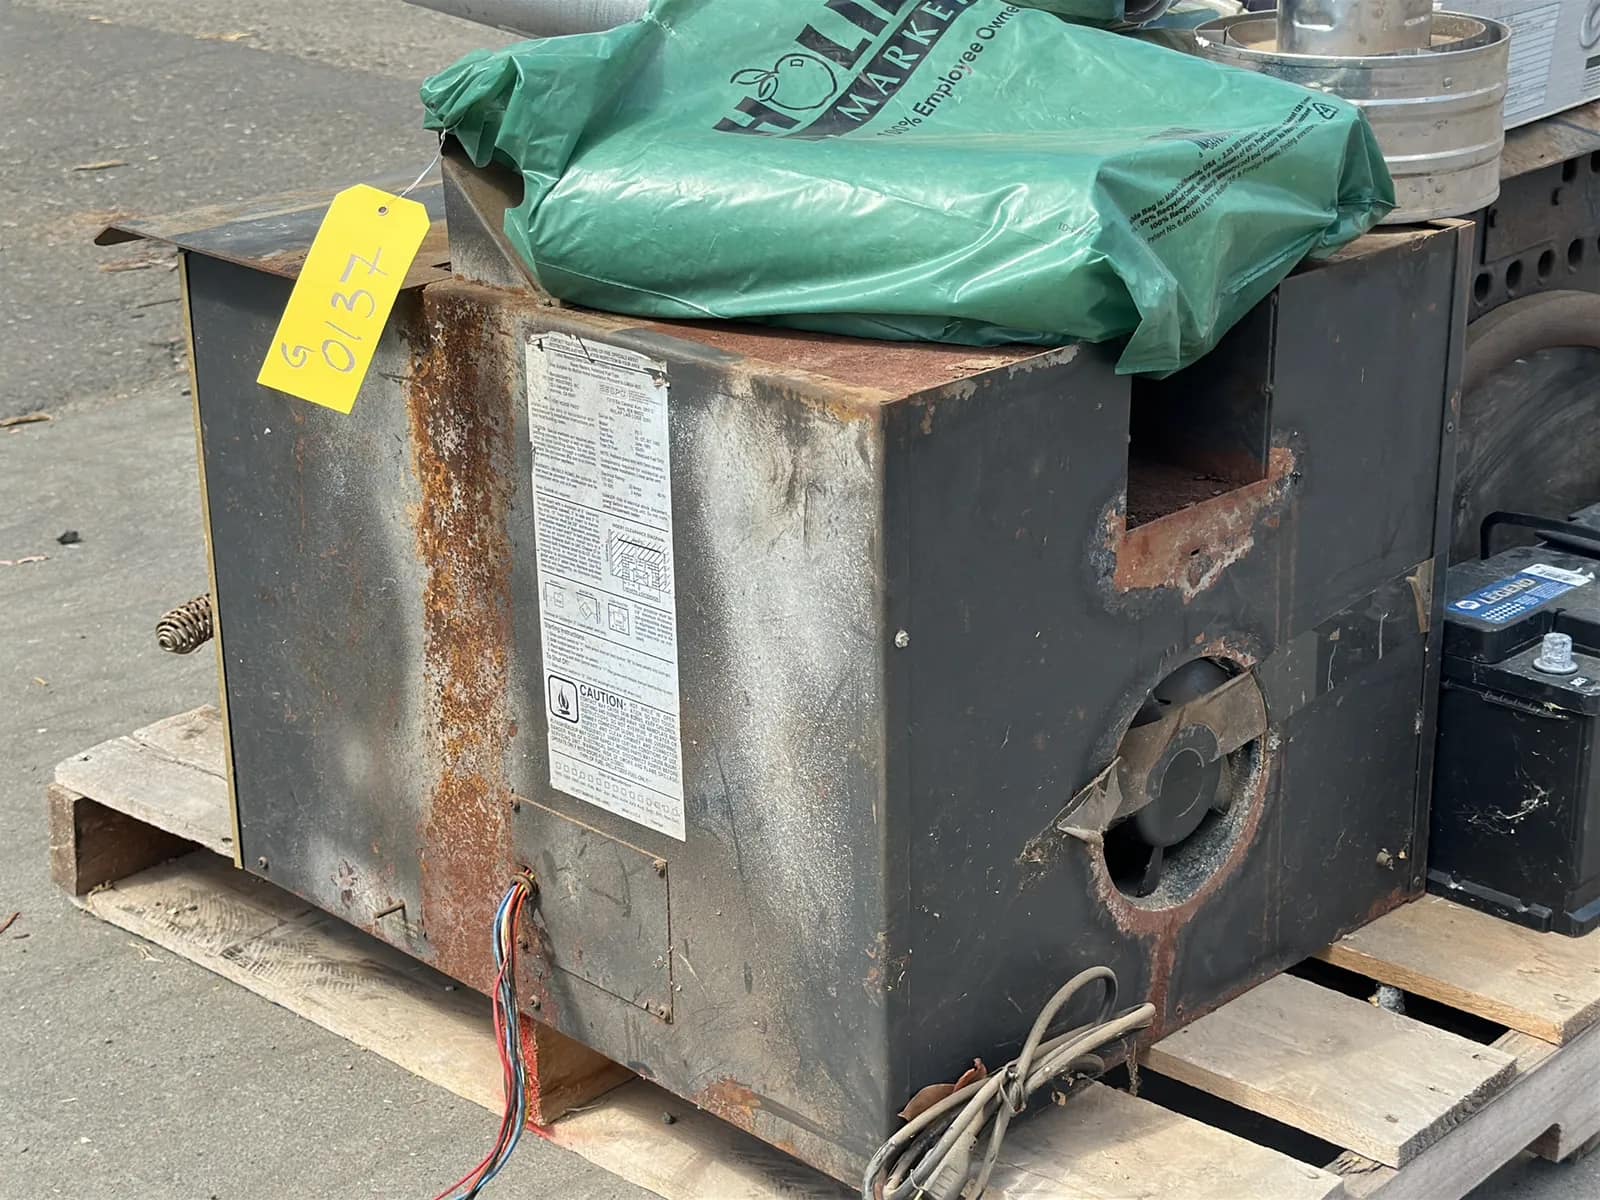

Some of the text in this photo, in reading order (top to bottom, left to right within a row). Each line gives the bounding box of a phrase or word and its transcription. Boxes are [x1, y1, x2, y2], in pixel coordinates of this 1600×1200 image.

[713, 0, 906, 138] HOLI
[836, 0, 969, 122] MARKE
[913, 43, 984, 117] Employee
[976, 5, 1020, 40] Owne
[321, 247, 389, 373] 0137
[1478, 578, 1537, 605] LEGEND
